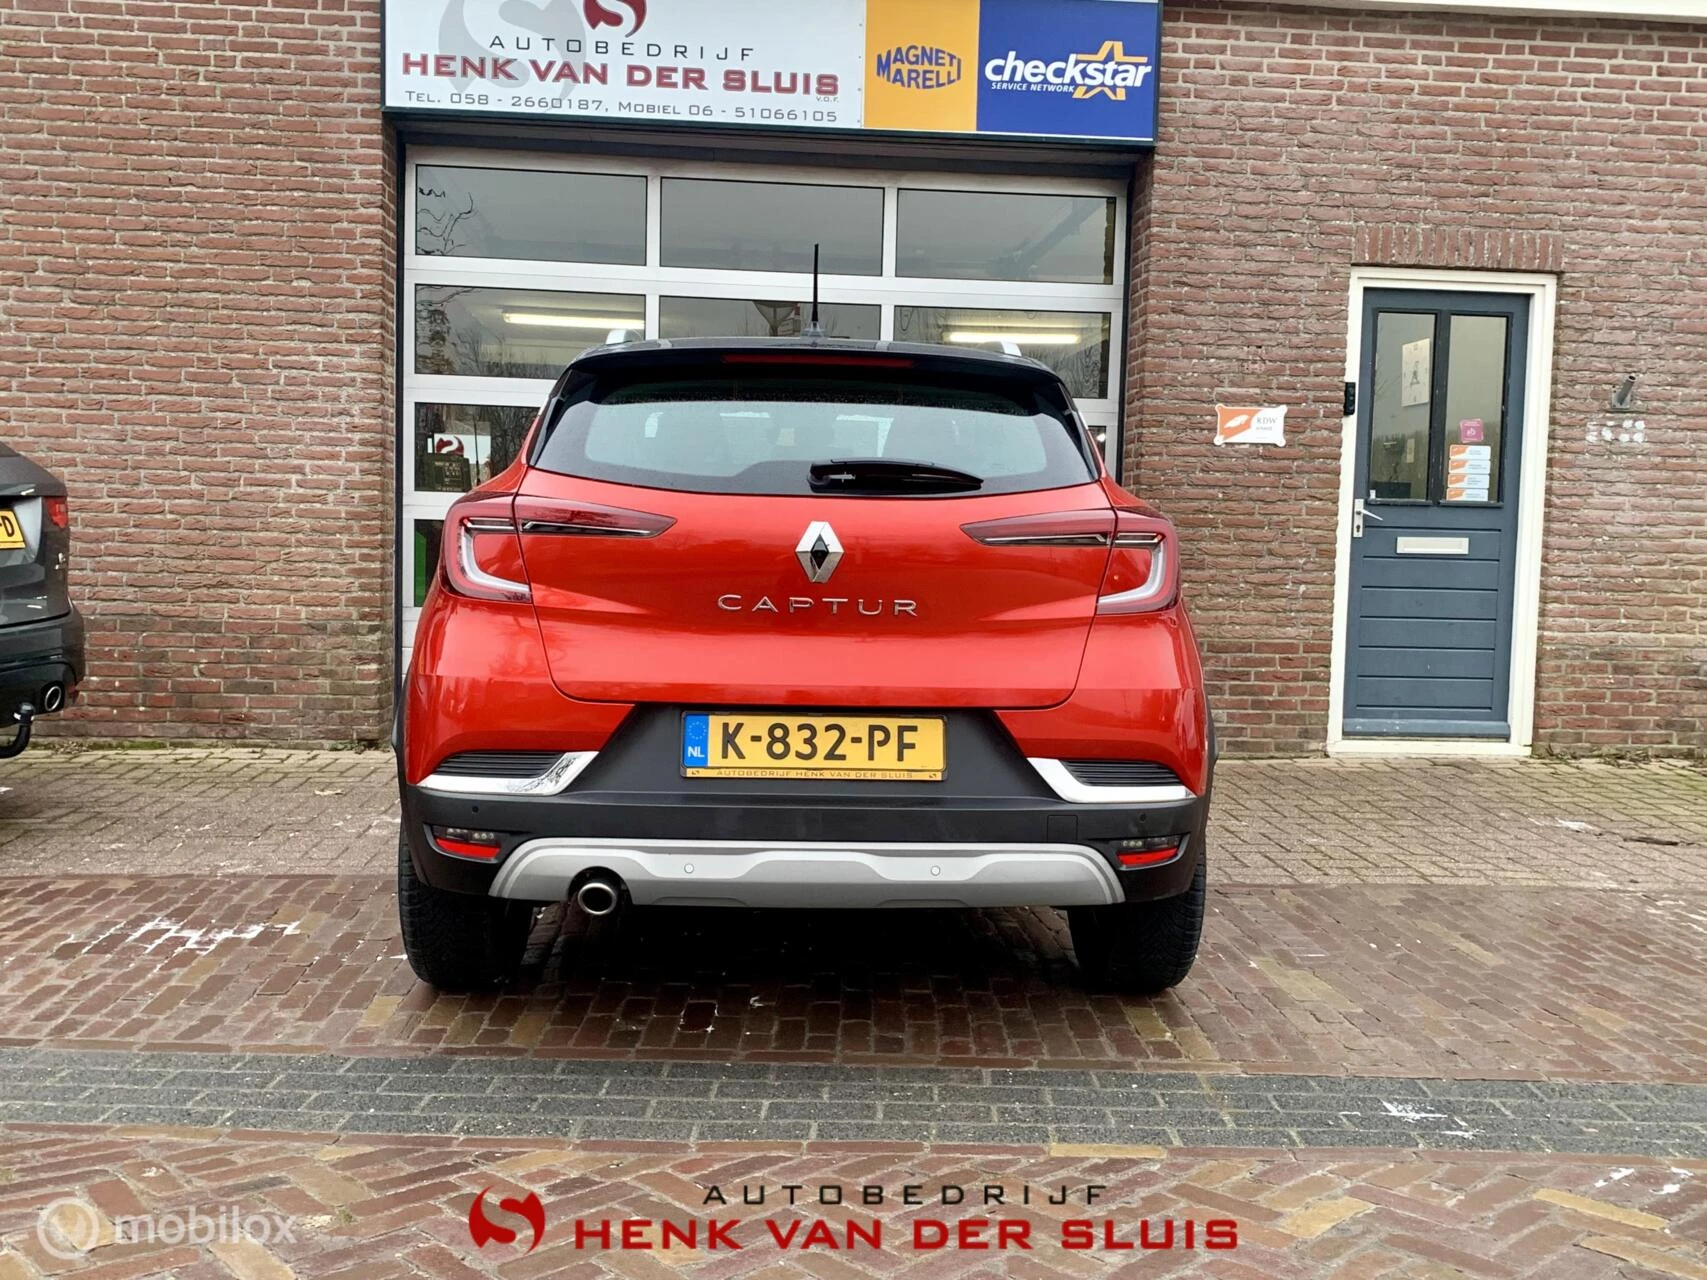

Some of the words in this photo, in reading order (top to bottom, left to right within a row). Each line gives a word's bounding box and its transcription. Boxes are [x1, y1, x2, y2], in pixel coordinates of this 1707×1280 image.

[489, 35, 754, 61] AUTOBEDRIJF
[876, 44, 962, 76] MAGNETI
[402, 52, 519, 81] HENK
[528, 58, 609, 86] VAN
[626, 63, 709, 91] DER
[722, 69, 839, 96] SLUIS
[984, 51, 1152, 88] checkstar
[991, 82, 1028, 92] SERVICE
[1030, 83, 1075, 93] NETWORK
[450, 92, 489, 106] 058
[511, 95, 609, 113] 2660187,
[689, 104, 713, 117] 06
[735, 106, 838, 122] 51066105
[1256, 416, 1277, 425] RDW
[717, 594, 918, 617] CAPTUR
[687, 747, 705, 759] NL
[720, 721, 919, 762] K-832-PF
[716, 769, 792, 778] AUTOBEDRIJF
[854, 771, 878, 779] DER
